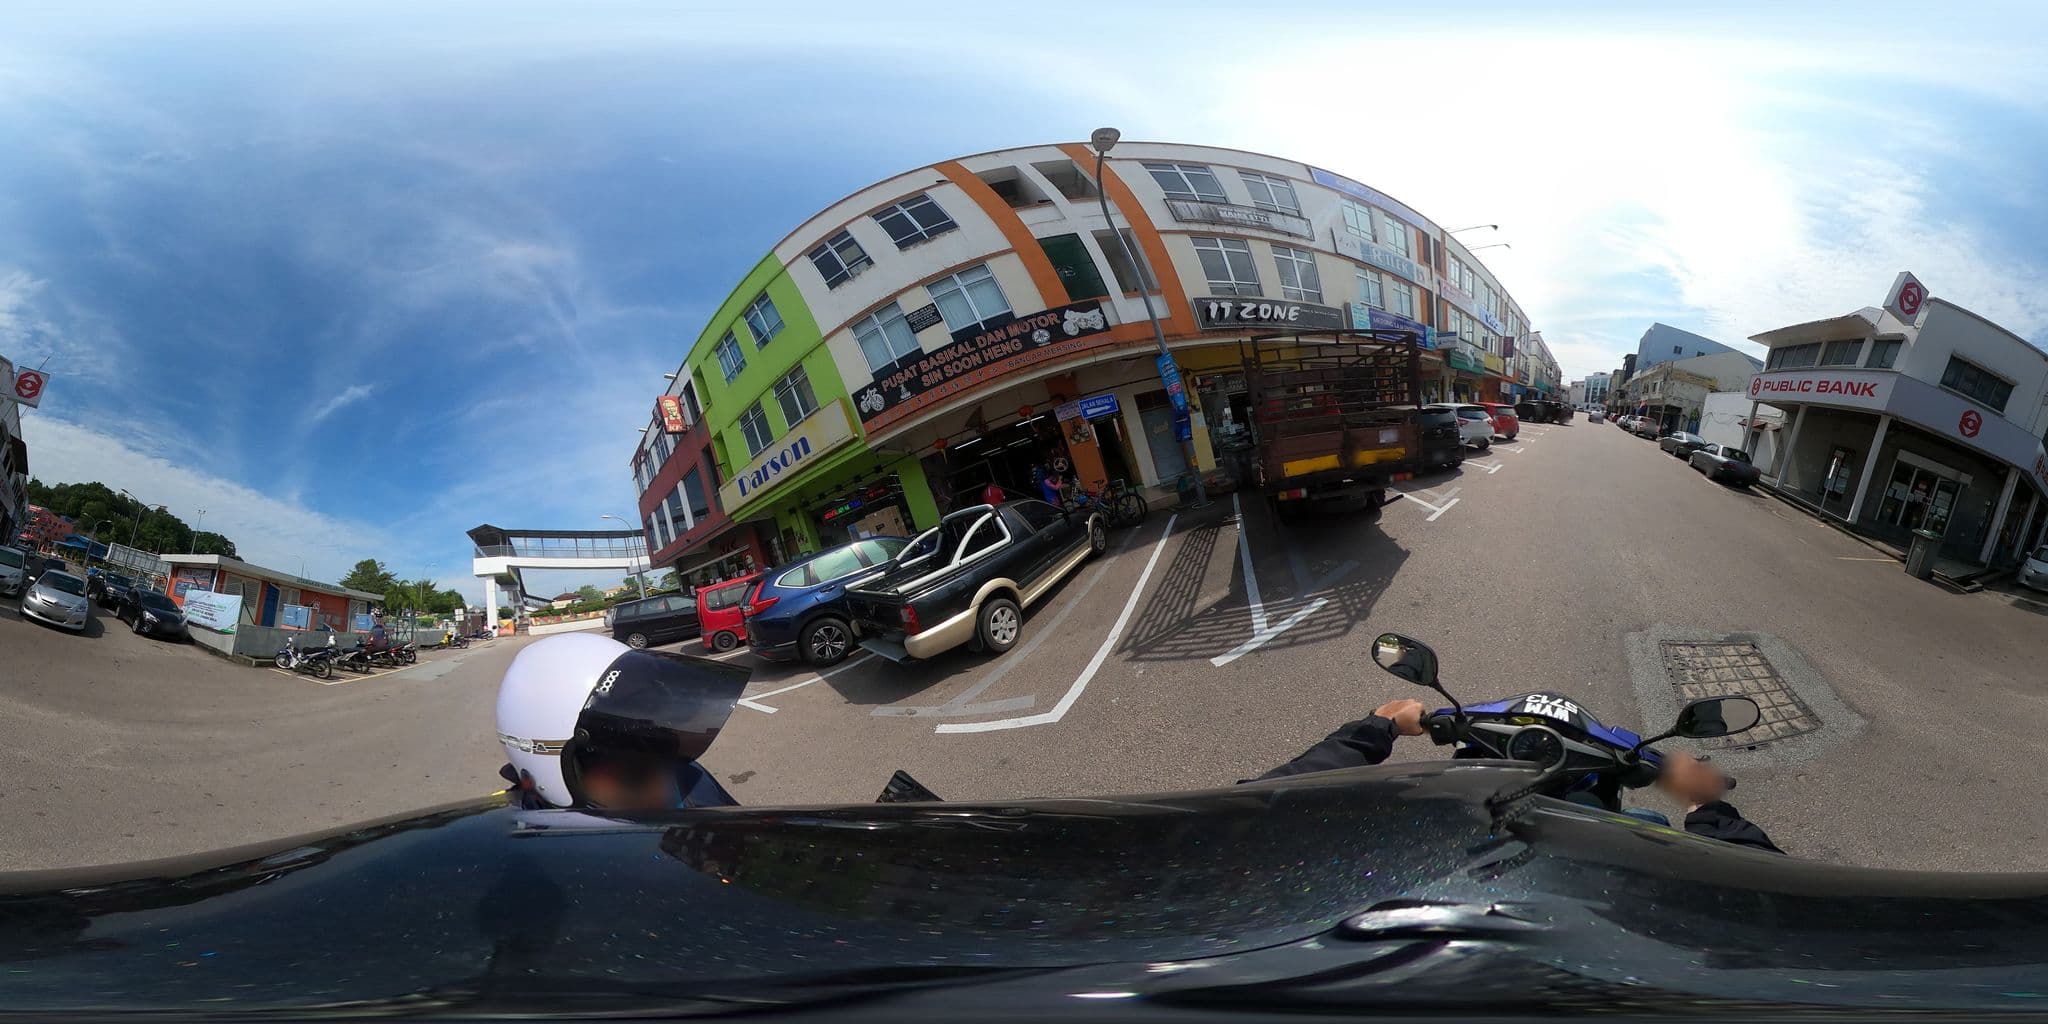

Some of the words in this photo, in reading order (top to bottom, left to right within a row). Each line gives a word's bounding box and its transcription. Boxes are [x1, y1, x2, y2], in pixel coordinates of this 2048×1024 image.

[1209, 302, 1233, 319] IT
[1240, 302, 1300, 321] ZONE
[881, 364, 918, 392] PUSAT
[919, 341, 976, 373] BASIKAL
[976, 329, 1008, 349] DAN
[1006, 312, 1060, 337] MOTOR
[921, 368, 944, 387] SIN
[943, 352, 982, 377] SOON
[981, 338, 1023, 362] HENG
[1763, 380, 1813, 393] PUBLIC
[1816, 380, 1879, 397] BANK
[737, 436, 811, 497] Darson
[1524, 702, 1569, 722] WYM
[1526, 694, 1578, 715] 5713
